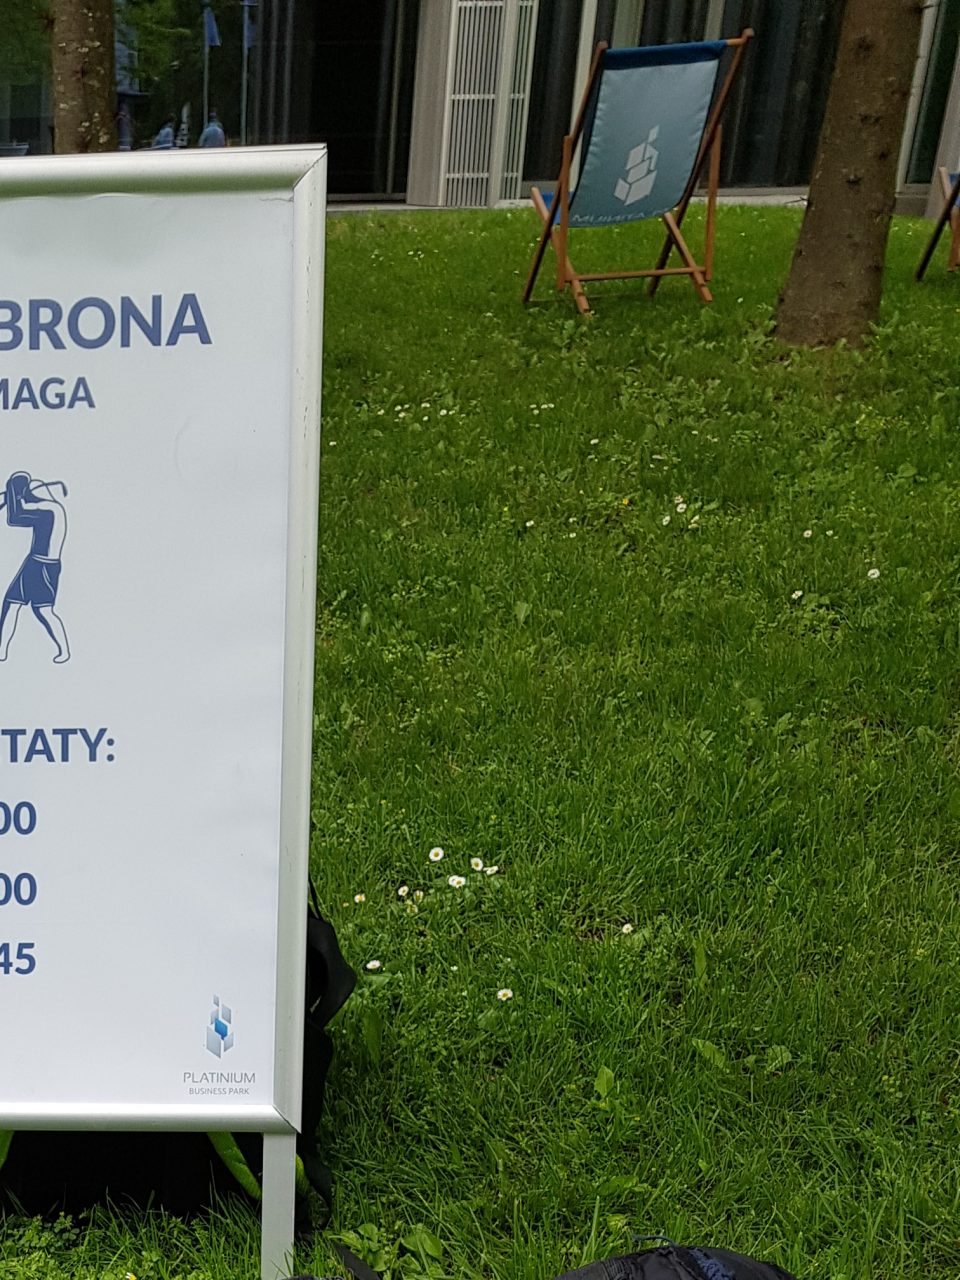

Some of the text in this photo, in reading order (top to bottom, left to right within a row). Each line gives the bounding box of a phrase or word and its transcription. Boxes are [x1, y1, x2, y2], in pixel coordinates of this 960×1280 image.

[183, 1072, 256, 1084] PLATINIUM
[189, 1087, 250, 1096] BUSINESS PARK
